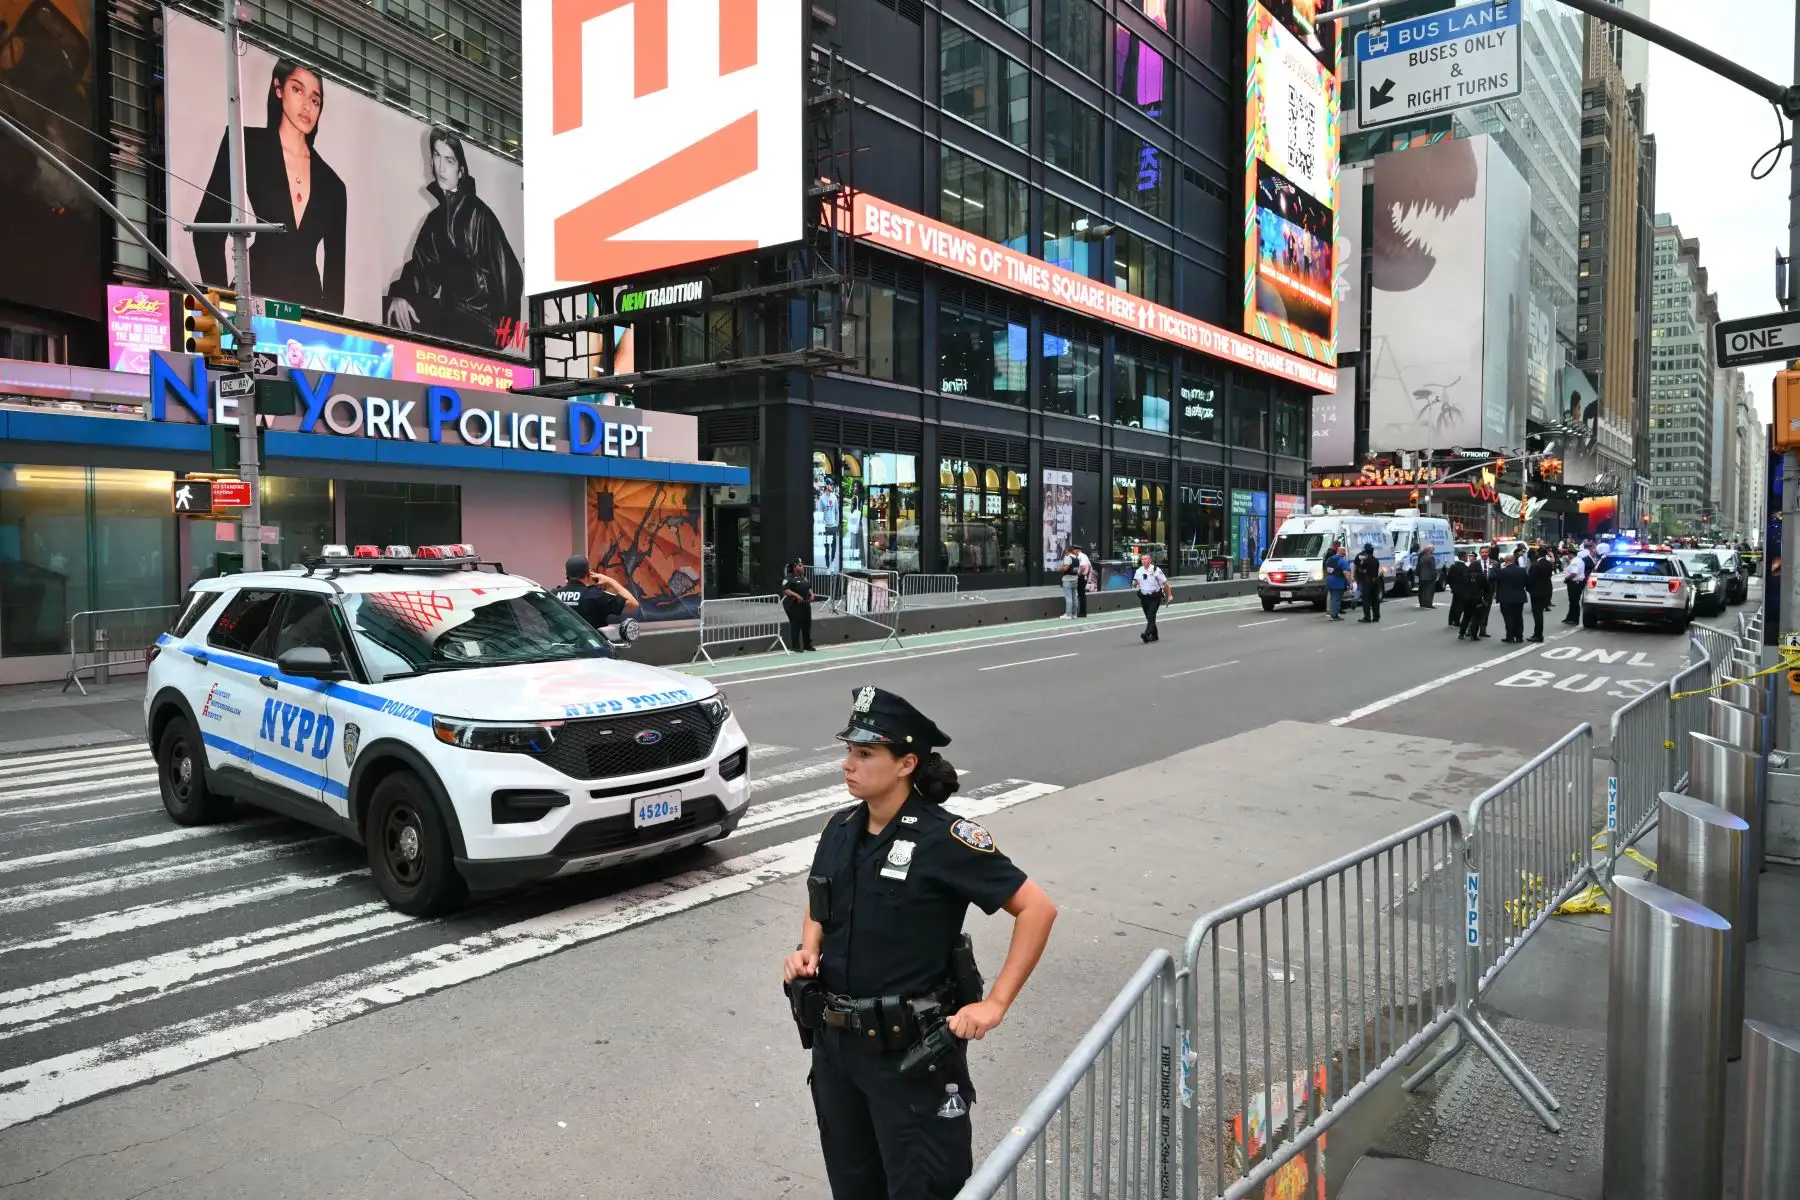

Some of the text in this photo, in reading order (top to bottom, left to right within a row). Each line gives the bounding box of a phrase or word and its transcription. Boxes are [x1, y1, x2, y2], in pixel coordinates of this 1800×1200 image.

[1399, 4, 1508, 45] BUS LANE
[1409, 31, 1507, 67] BUSES ONLY
[1450, 62, 1463, 78] &
[1407, 85, 1452, 109] RIGHT
[1457, 72, 1509, 97] TURNS
[865, 203, 915, 245] BEST
[918, 223, 977, 268] VIEWS
[980, 247, 1004, 276] OF
[1004, 255, 1050, 292] TIMES
[1051, 272, 1104, 311] SQUARE
[1106, 293, 1136, 322] HERE
[1158, 311, 1198, 343] TICKETS
[1200, 326, 1212, 348] TO
[1212, 332, 1230, 354] THE
[1230, 338, 1255, 362] TIMES
[1255, 347, 1285, 370] SQUARE
[273, 303, 280, 317] 7
[1731, 327, 1784, 352] ONE
[415, 349, 513, 378] BROADWAY'S
[415, 361, 468, 382] BIGGEST
[470, 372, 494, 388] POP
[222, 376, 250, 391] ONE WAY
[150, 350, 653, 457] NE YORK POLICE DEPT
[1180, 486, 1224, 507] TIMES
[556, 591, 581, 601] NYPD
[1540, 646, 1690, 670] ONL
[1494, 668, 1659, 699] BUS
[383, 699, 420, 721] POLICE
[561, 689, 694, 717] NYPD POLICE
[260, 697, 335, 760] NYPD
[639, 801, 669, 820] 4520
[1607, 778, 1617, 829] NYPD
[1467, 875, 1479, 945] NYPD
[1161, 1045, 1171, 1110] FRIEDRICHS
